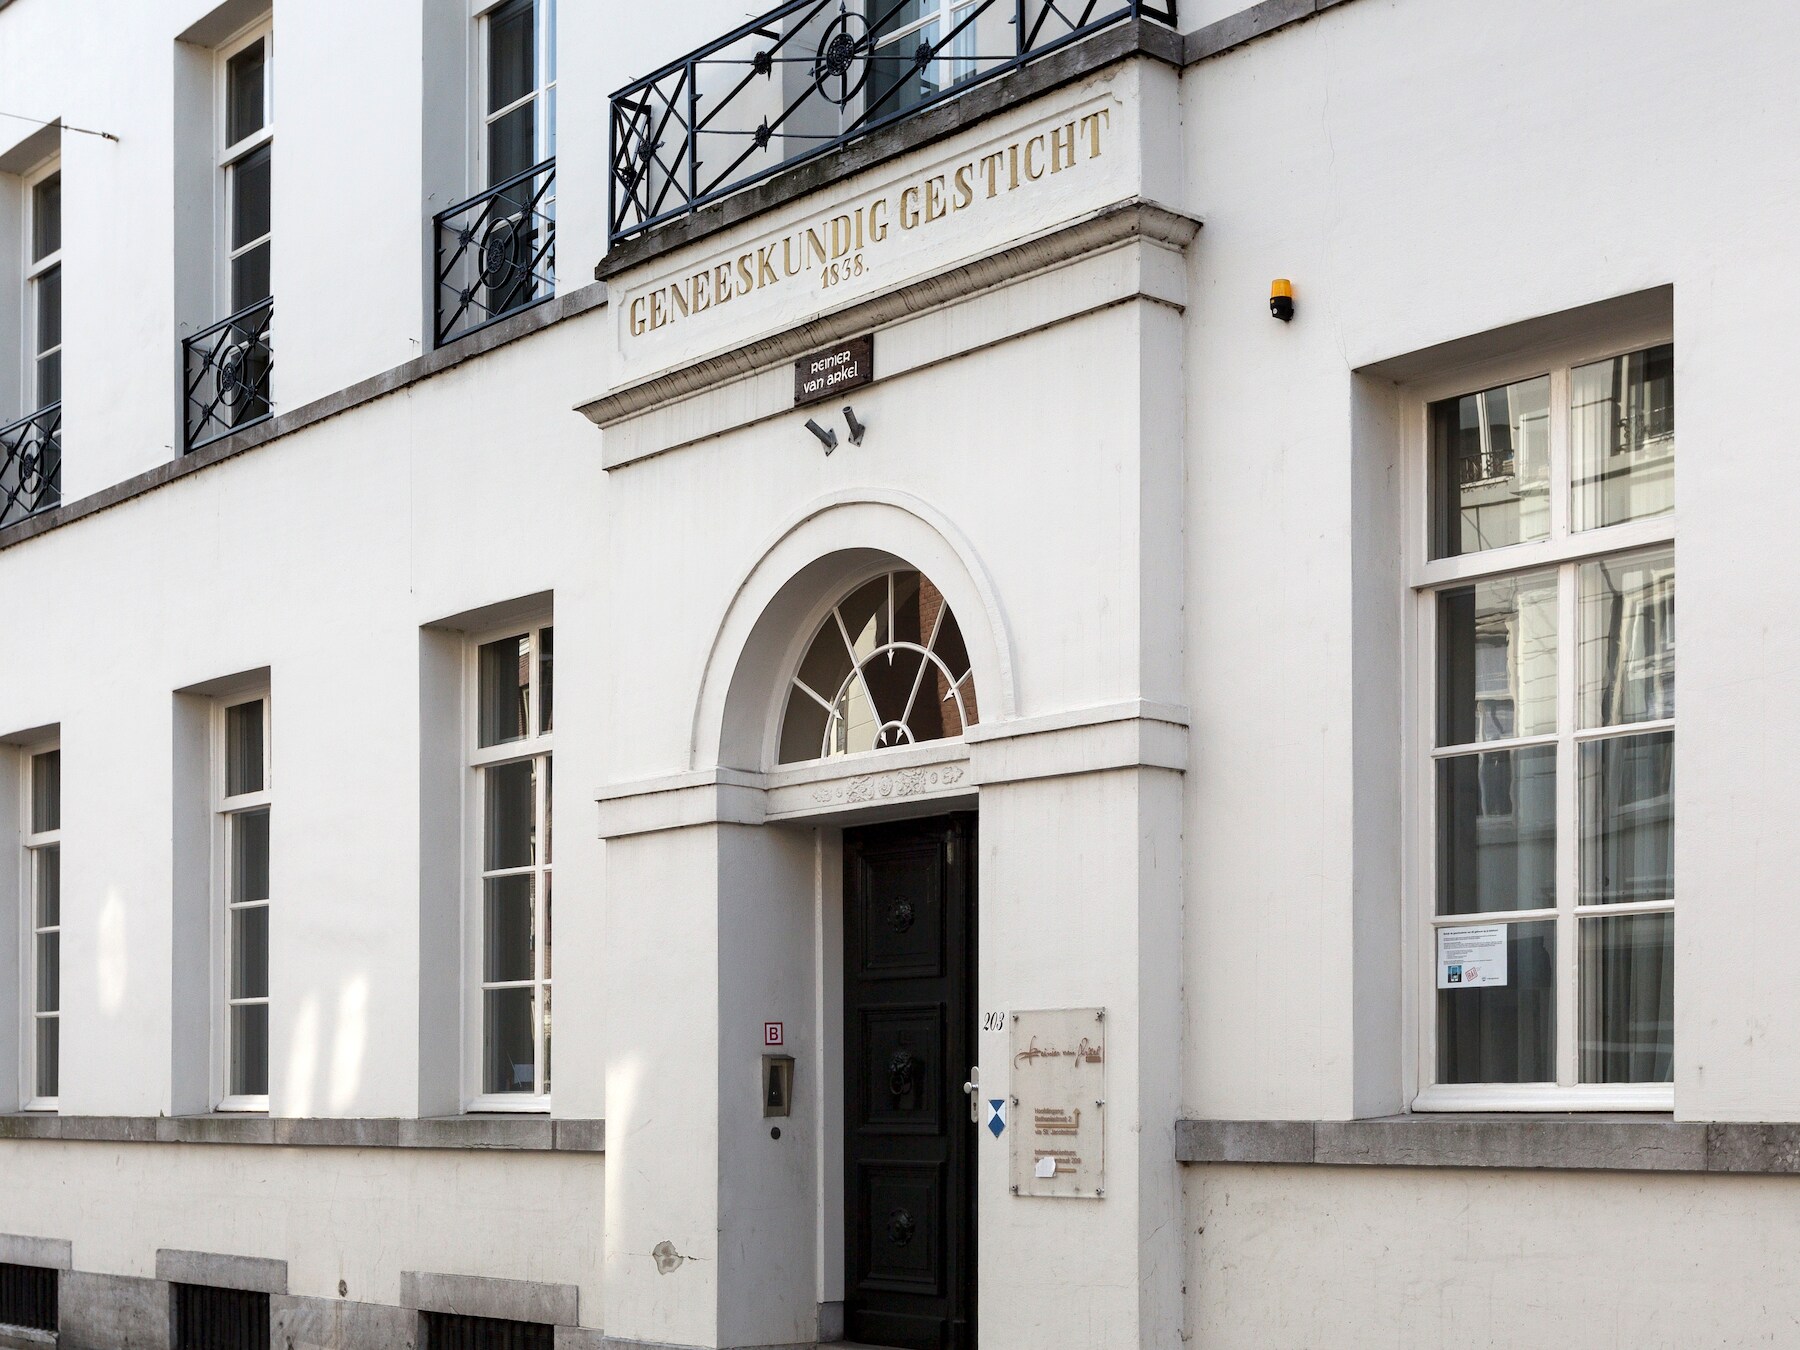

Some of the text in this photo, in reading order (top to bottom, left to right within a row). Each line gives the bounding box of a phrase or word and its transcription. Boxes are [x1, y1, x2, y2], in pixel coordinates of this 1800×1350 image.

[630, 108, 1110, 337] GENEESKUNDIG GESTICHT
[803, 378, 824, 394] van
[983, 1011, 1005, 1031] 203
[769, 1027, 779, 1041] B
